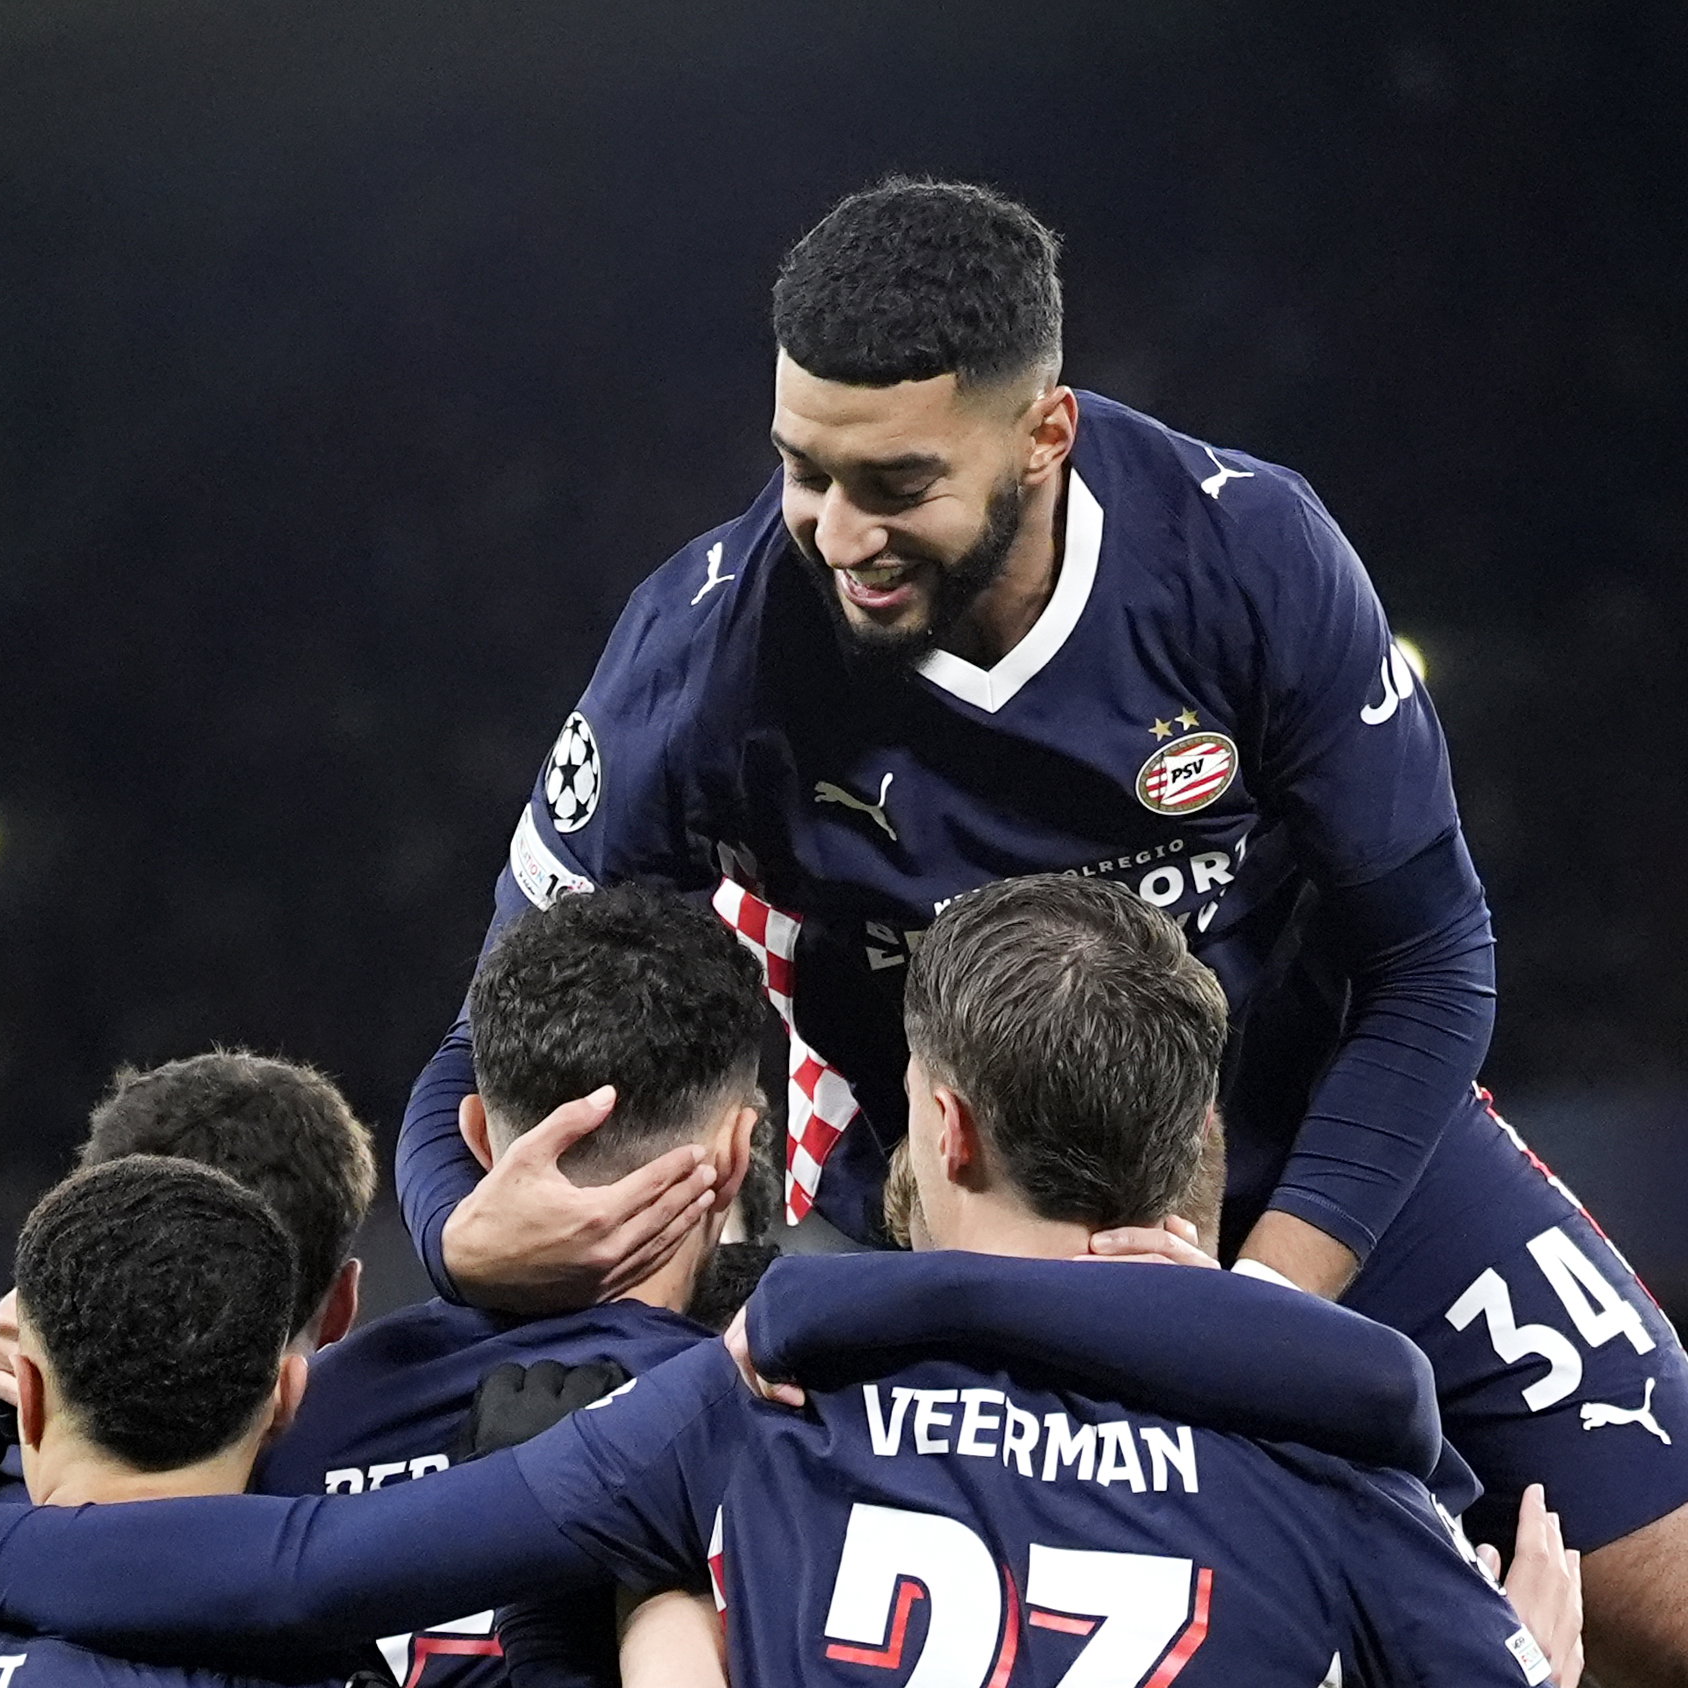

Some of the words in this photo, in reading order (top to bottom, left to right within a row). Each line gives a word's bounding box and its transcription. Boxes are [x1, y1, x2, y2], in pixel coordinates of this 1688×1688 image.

[1171, 757, 1205, 784] PSV
[1444, 1225, 1657, 1413] 34
[862, 1383, 1200, 1494] VEERMAN
